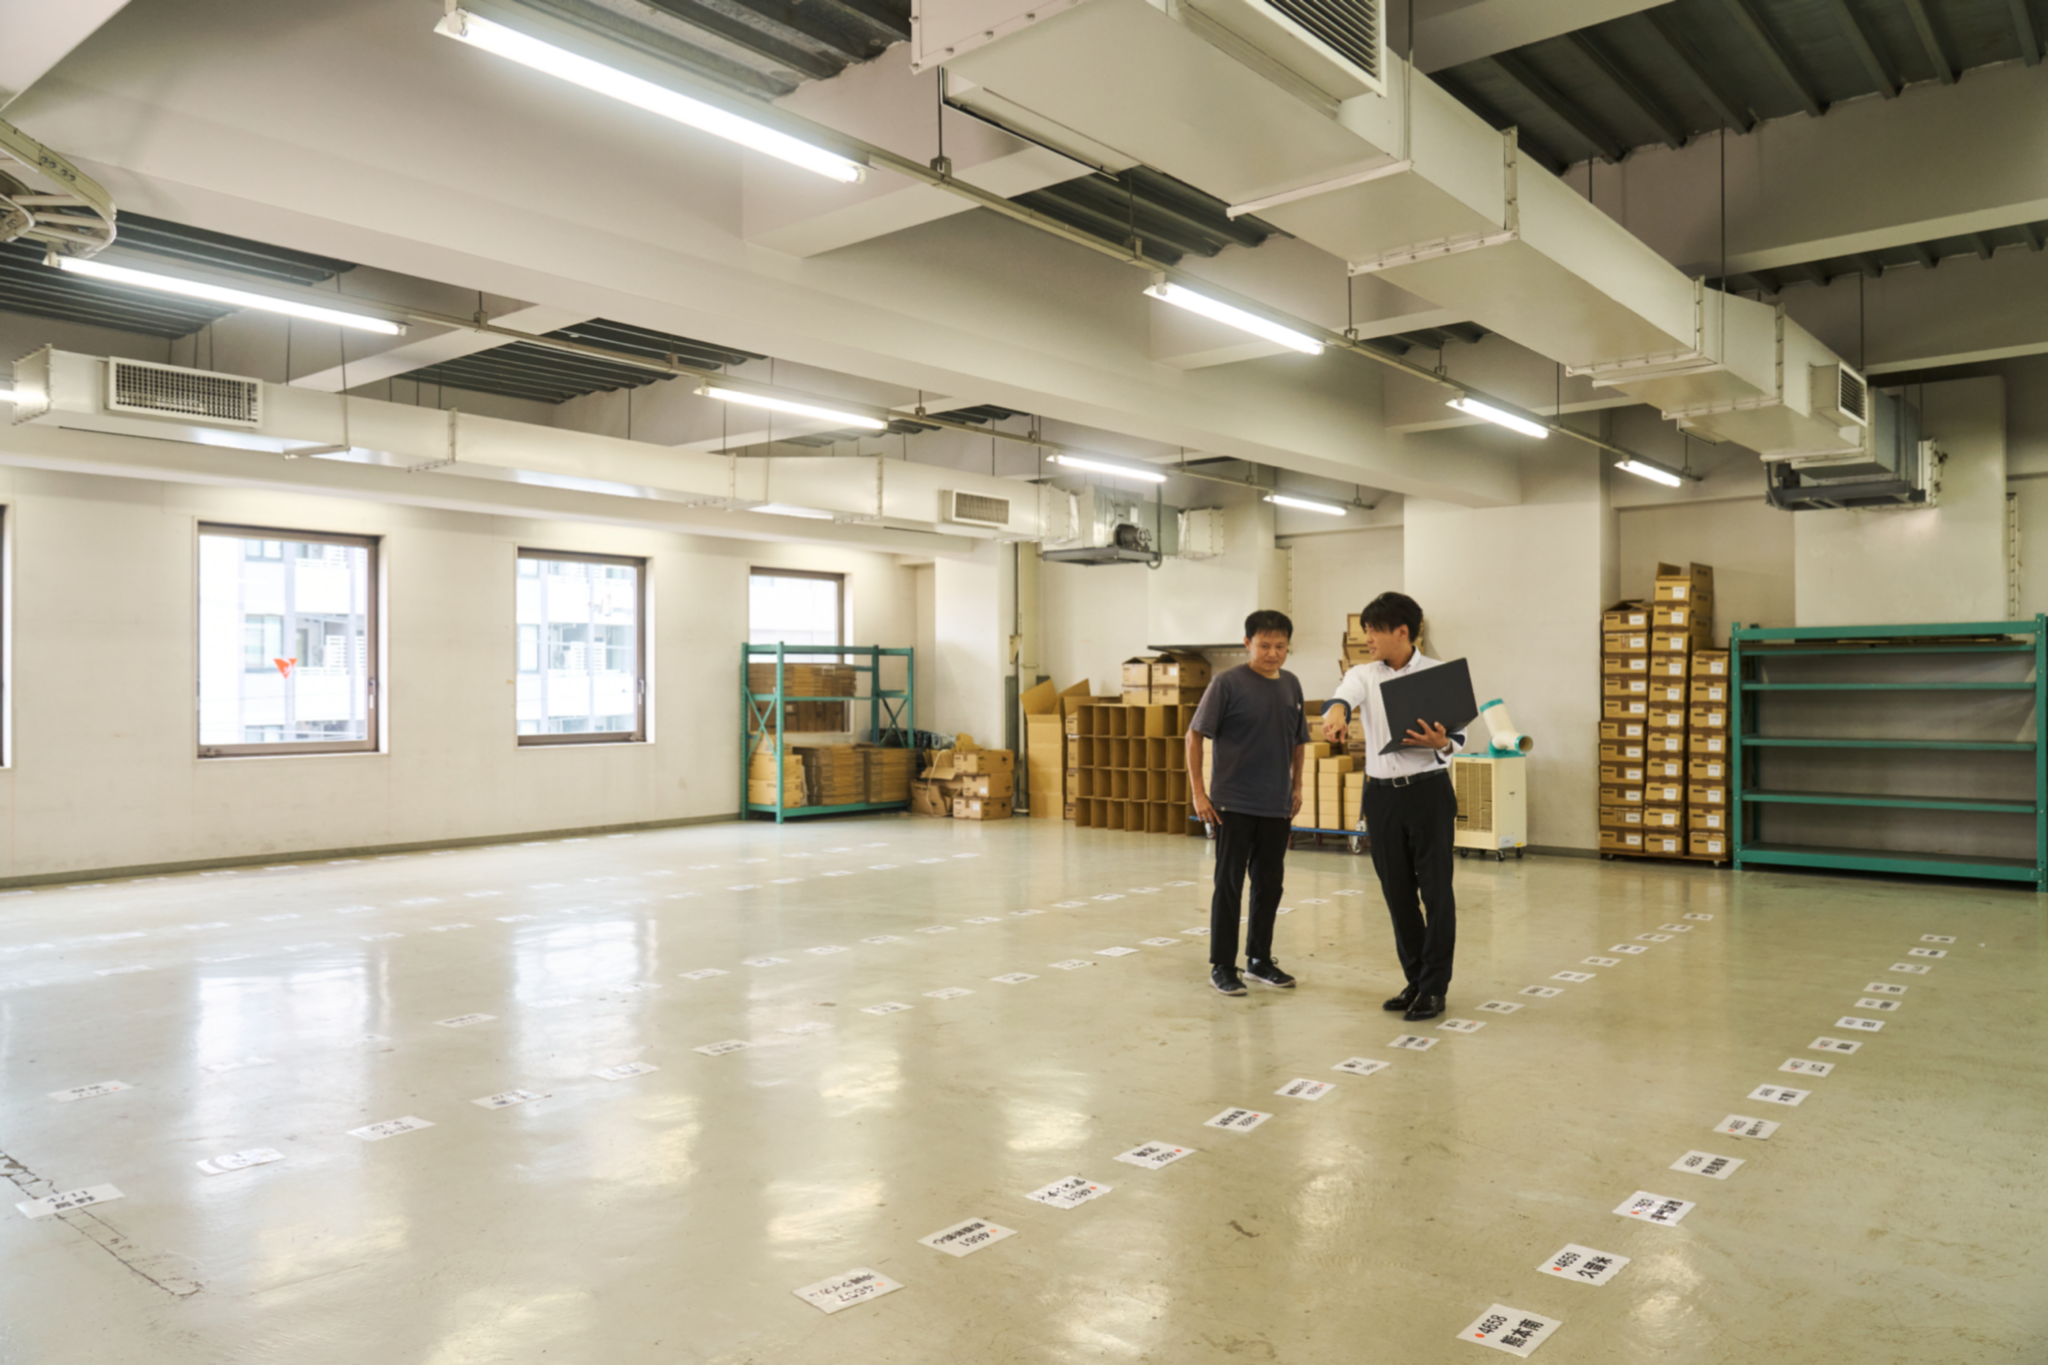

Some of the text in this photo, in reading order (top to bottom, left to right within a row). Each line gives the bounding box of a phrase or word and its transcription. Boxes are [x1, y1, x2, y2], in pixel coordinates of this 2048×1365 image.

[1555, 1252, 1581, 1267] 4659
[1577, 1256, 1612, 1279] 久留米
[1478, 1314, 1507, 1334] 4658
[1500, 1318, 1545, 1348] 熊本南
